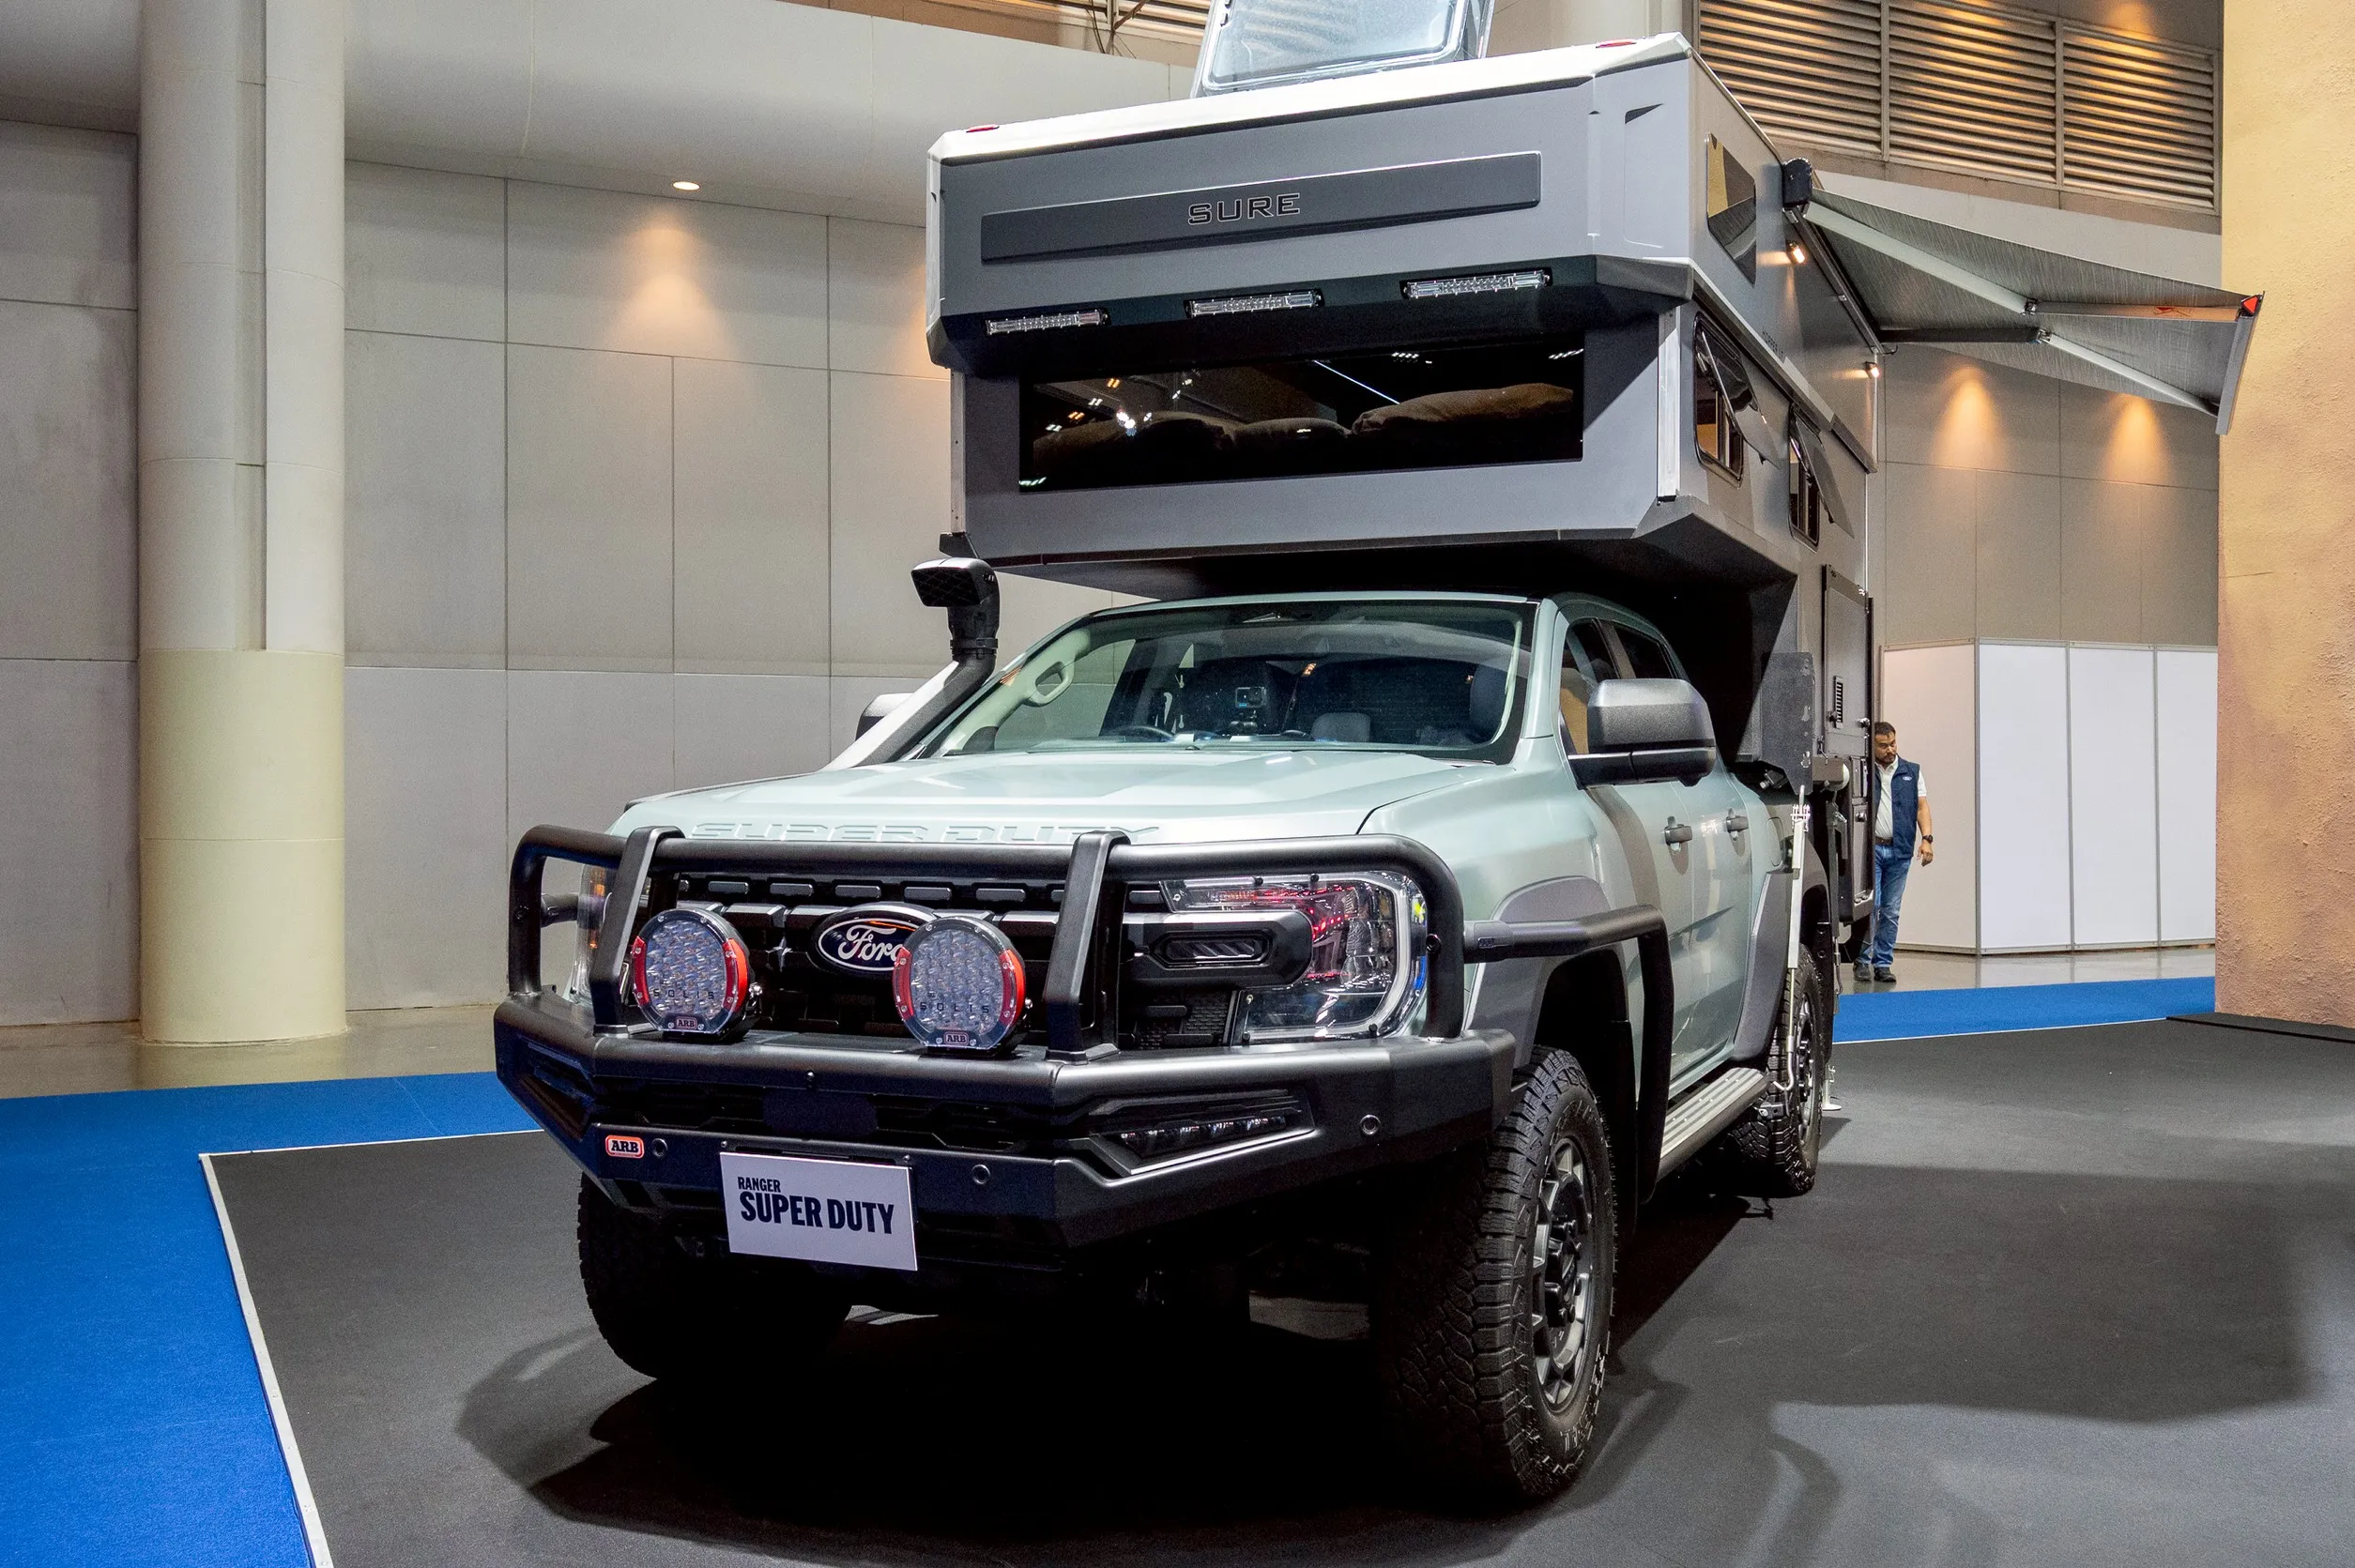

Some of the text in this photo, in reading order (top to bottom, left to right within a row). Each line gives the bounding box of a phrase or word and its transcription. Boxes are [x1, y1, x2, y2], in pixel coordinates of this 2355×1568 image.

[1188, 192, 1300, 225] SURE
[689, 822, 930, 843] SUPER
[652, 988, 714, 999] SOLIS
[920, 1001, 989, 1013] SOLIS
[677, 1019, 695, 1028] ARB
[946, 1035, 967, 1043] ARB
[611, 1140, 639, 1153] ARB
[738, 1177, 781, 1193] RANGER
[740, 1192, 895, 1235] SUPER DUTY
